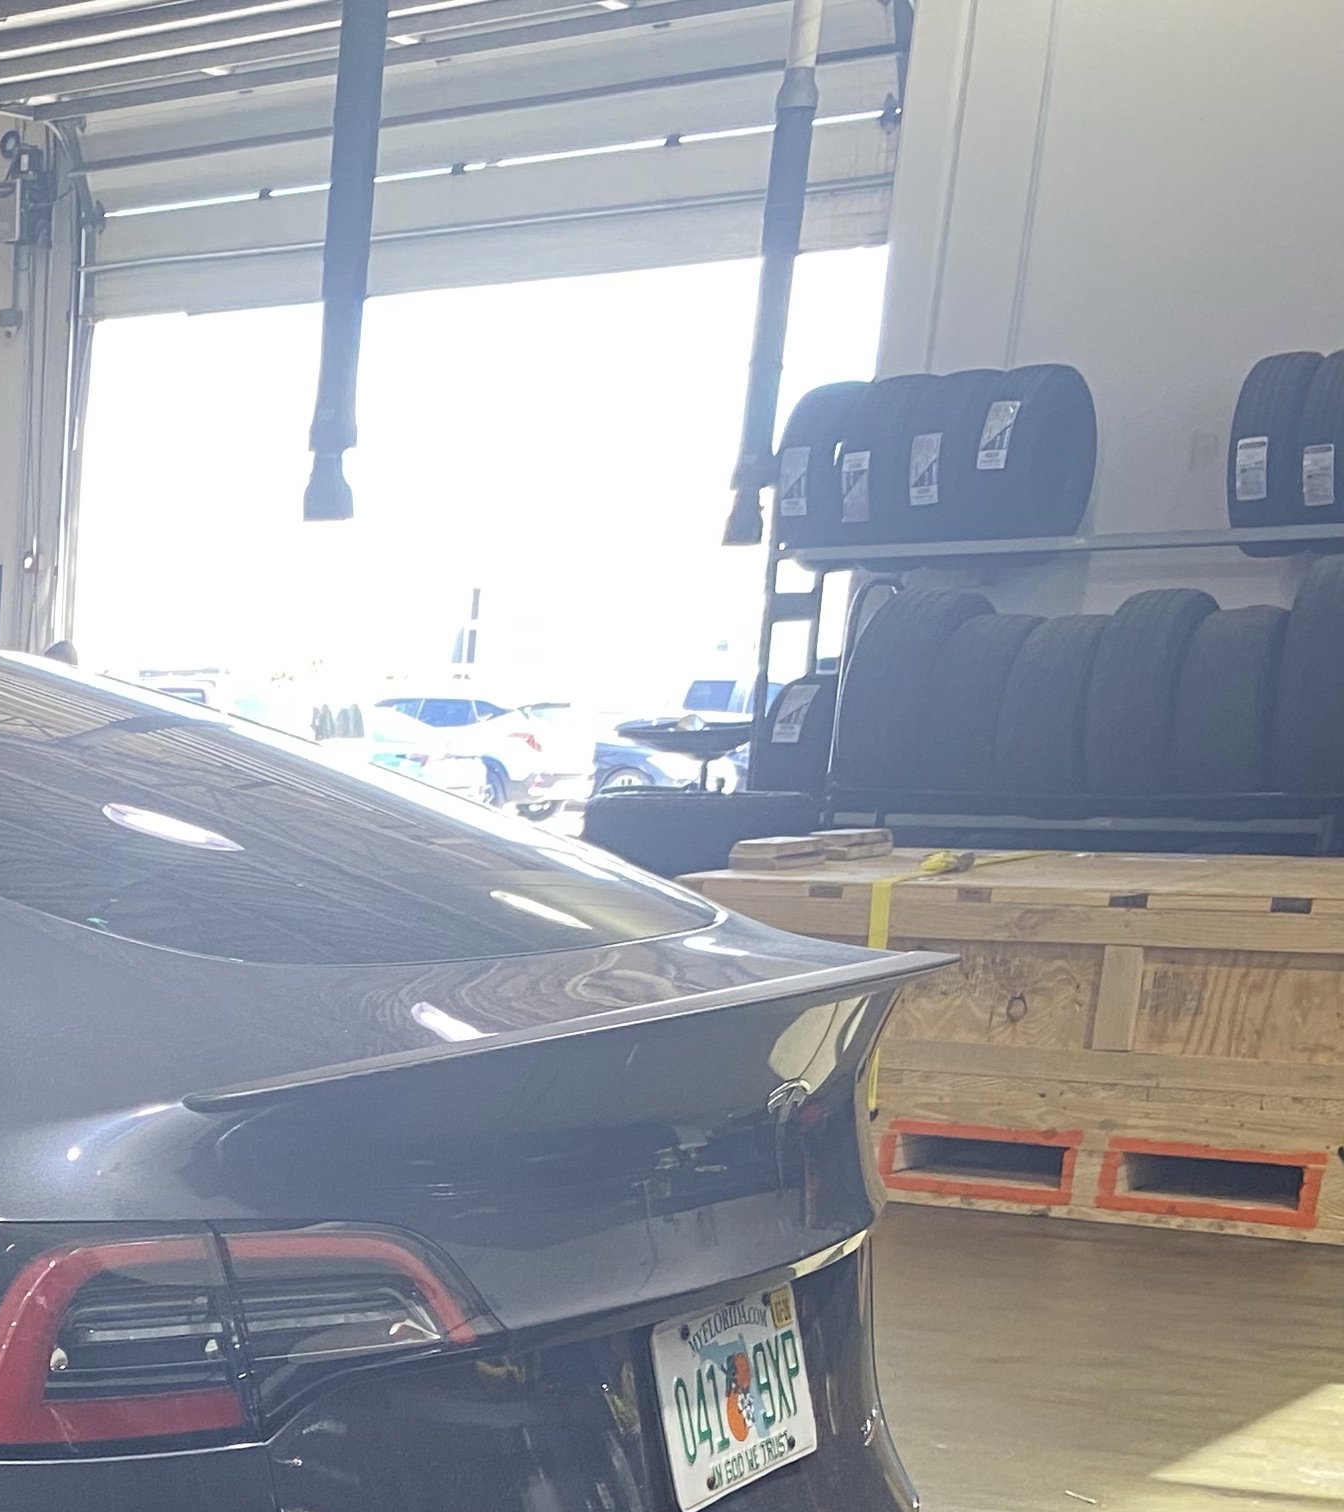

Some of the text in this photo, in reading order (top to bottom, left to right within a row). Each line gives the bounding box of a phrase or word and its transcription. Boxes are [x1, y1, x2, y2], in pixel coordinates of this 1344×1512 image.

[688, 1304, 768, 1356] MYFLORIDA.COM
[674, 1330, 800, 1467] 041 9XP
[725, 1453, 745, 1484] GOD
[745, 1444, 760, 1471] WE
[760, 1430, 789, 1467] TRUST
